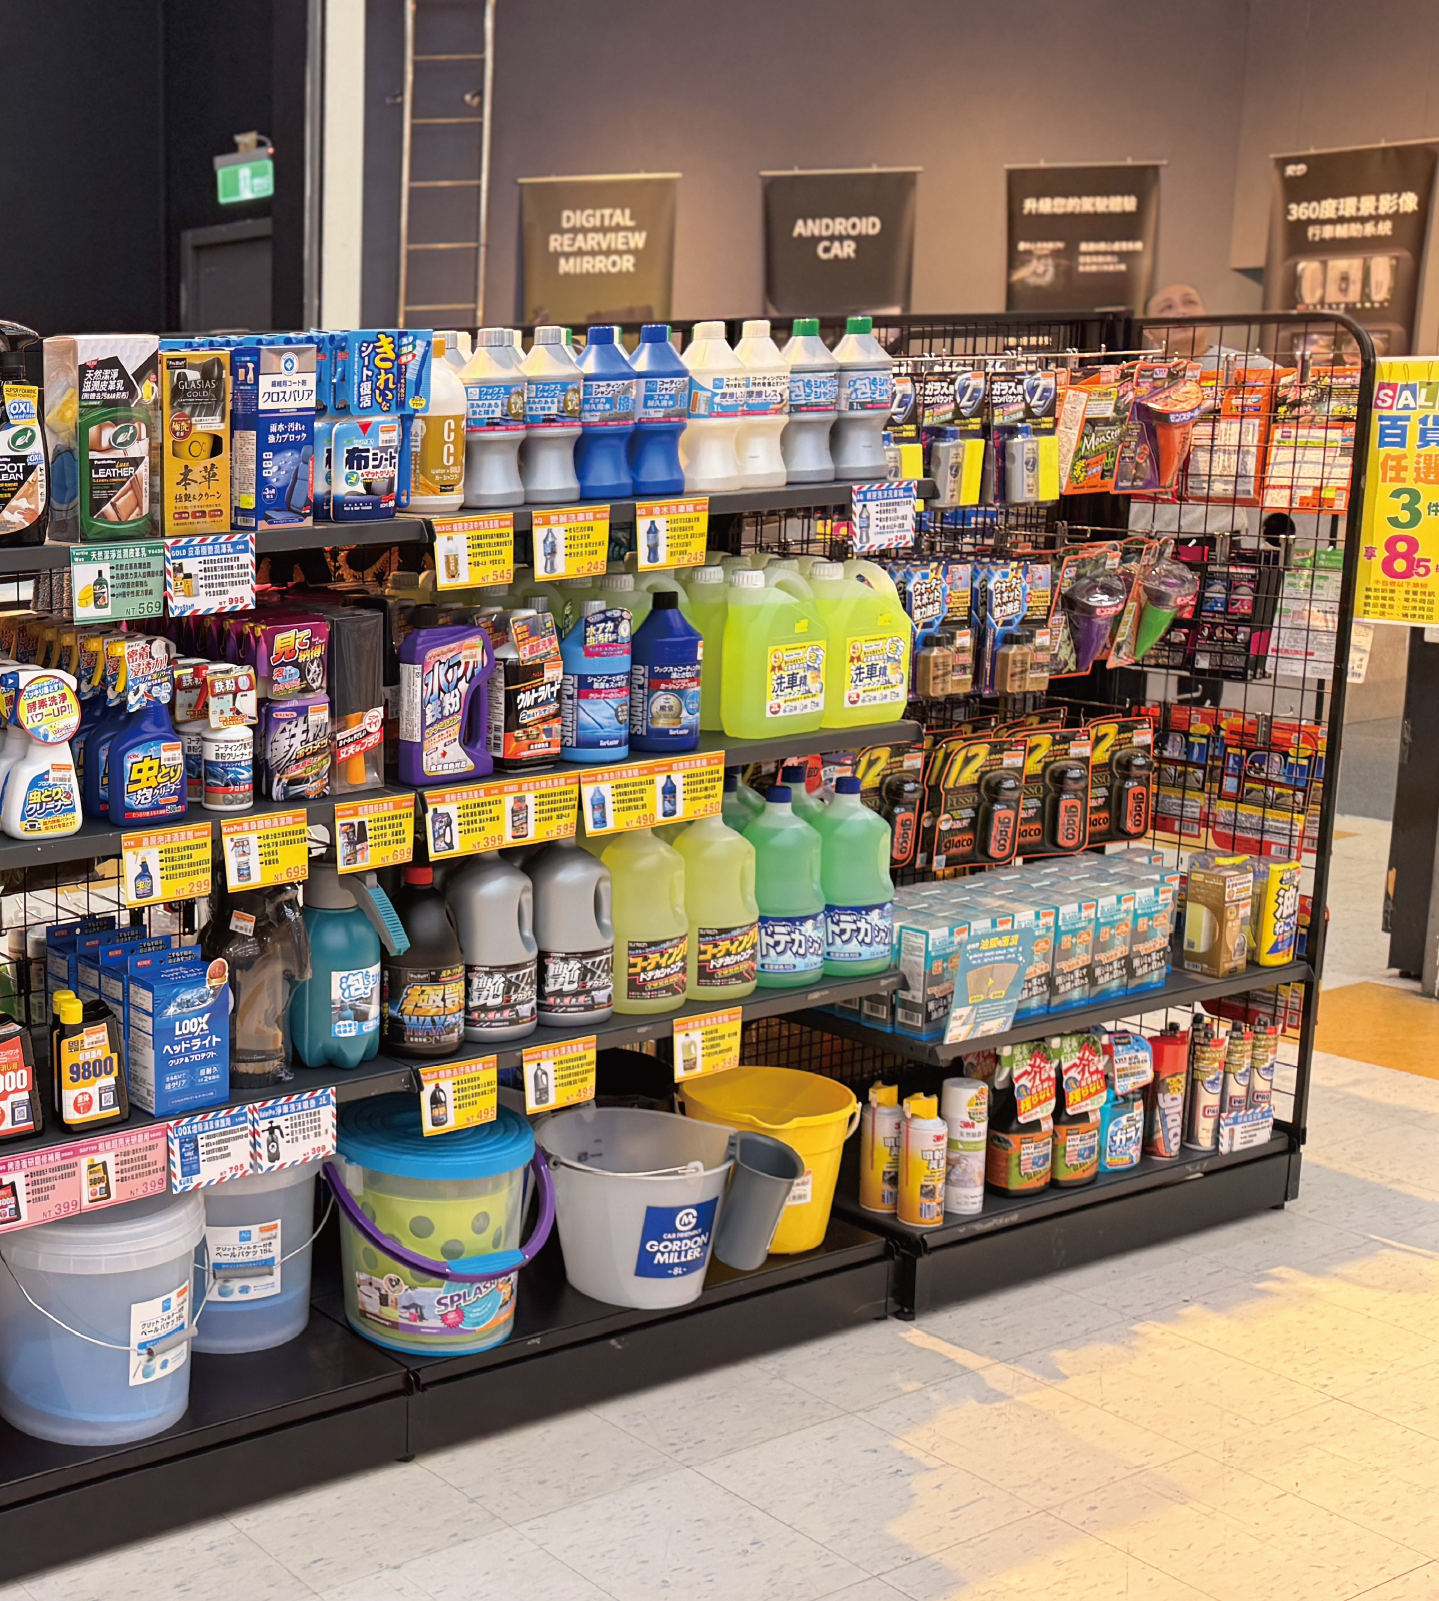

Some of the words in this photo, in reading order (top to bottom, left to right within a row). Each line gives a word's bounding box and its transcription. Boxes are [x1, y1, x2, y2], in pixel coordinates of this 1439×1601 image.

[560, 208, 636, 230] DIGITAL
[792, 216, 882, 239] ANDROID
[548, 231, 647, 252] REARVIEW
[816, 240, 856, 260] CAR
[558, 254, 636, 275] MIRROR
[178, 379, 217, 391] GLASIAS
[186, 389, 210, 398] GOLD
[262, 389, 314, 405] クロスバリア
[1373, 381, 1439, 411] SAL
[91, 467, 135, 478] LEATHER
[676, 556, 685, 564] NT
[686, 550, 705, 563] 245
[576, 566, 585, 574] NT
[586, 560, 606, 573] 245
[481, 574, 490, 582] NT
[492, 569, 512, 582] 545
[126, 607, 136, 616] NT
[138, 601, 162, 615] 569
[228, 597, 245, 605] 995
[629, 663, 646, 737] SHAMPOO
[562, 673, 574, 747] SHAMPOO
[702, 802, 721, 815] 450
[1130, 791, 1146, 829] glaco
[635, 812, 656, 825] 490
[1063, 803, 1080, 843] glaco
[555, 822, 576, 836] 595
[996, 814, 1013, 853] glaco
[482, 834, 504, 848] 399
[380, 854, 390, 863] NT
[392, 847, 412, 861] 699
[274, 872, 284, 882] NT
[285, 864, 307, 879] 695
[175, 886, 186, 896] NT
[188, 879, 210, 894] 299
[175, 1013, 211, 1036] LOOX
[404, 1015, 448, 1036] WAX
[162, 1035, 223, 1056] ヘッドライト
[69, 1054, 114, 1084] 9800
[721, 1055, 739, 1068] 349
[576, 1085, 595, 1098] 495
[476, 1106, 496, 1120] 495
[173, 1123, 193, 1138] LOOX
[310, 1144, 328, 1155] 399
[228, 1163, 245, 1174] 795
[130, 1187, 140, 1197] NT
[142, 1177, 166, 1194] 399
[42, 1210, 53, 1220] NT
[53, 1199, 79, 1218] 399
[645, 1231, 710, 1253] GORDON
[662, 1232, 676, 1240] CAR
[435, 1278, 499, 1315] SPLASH
